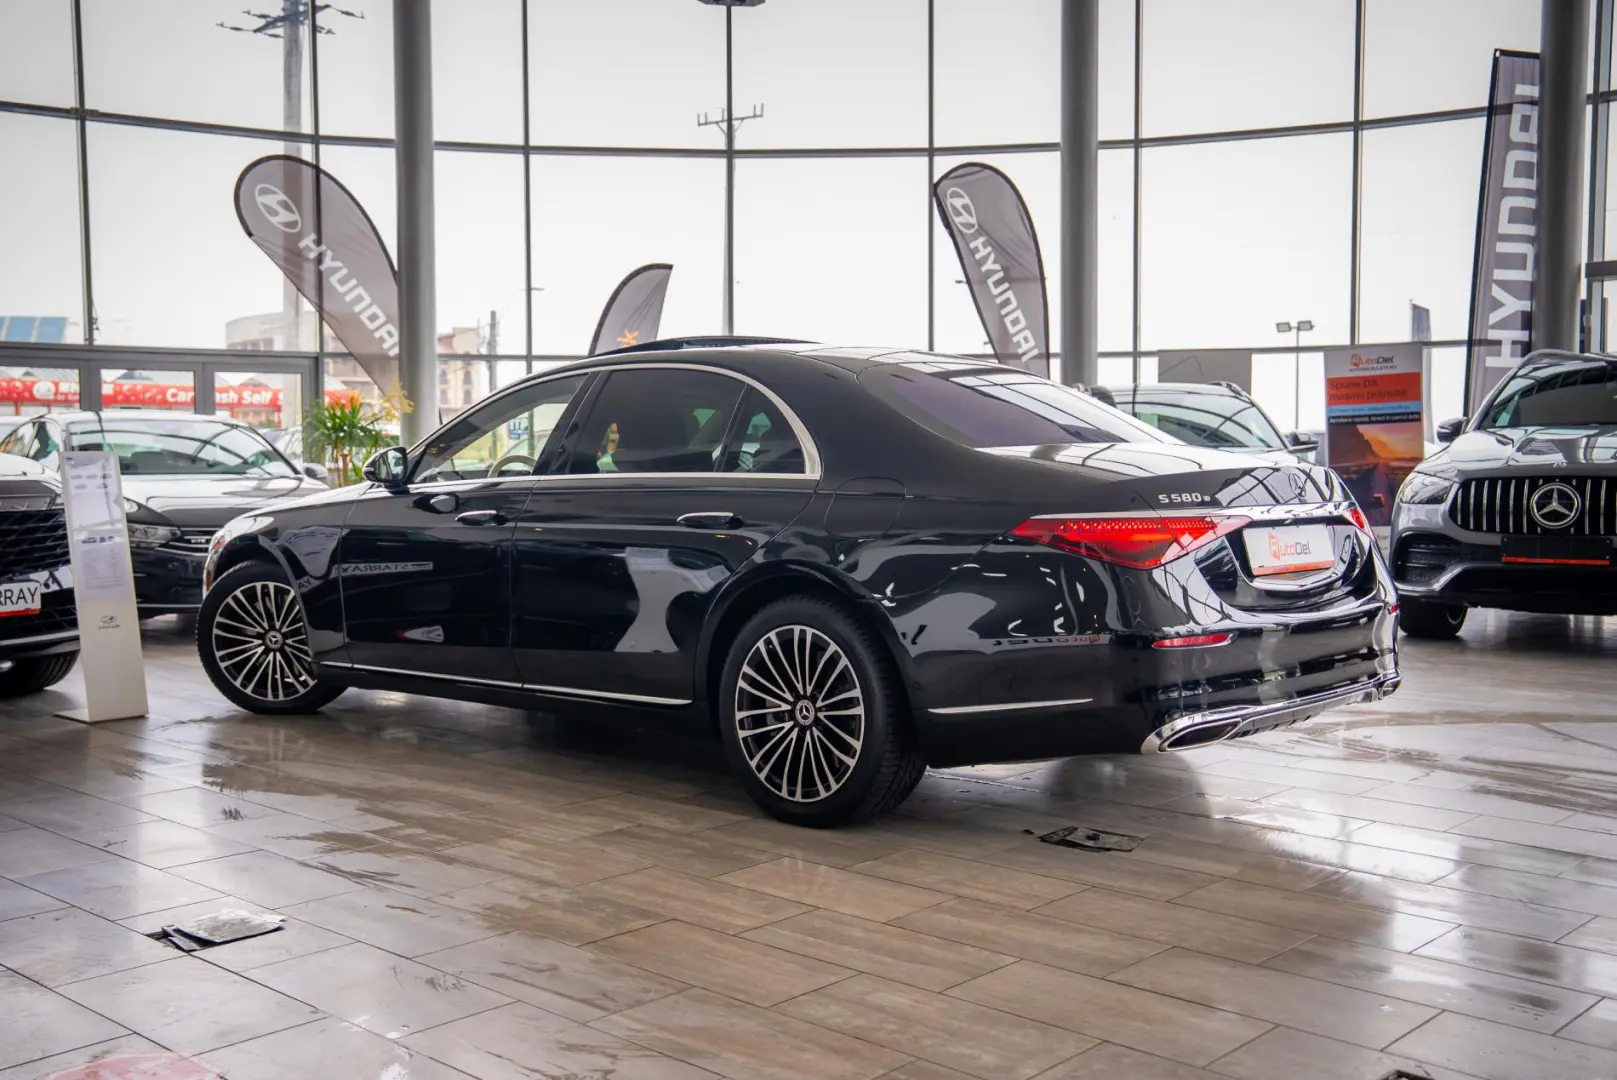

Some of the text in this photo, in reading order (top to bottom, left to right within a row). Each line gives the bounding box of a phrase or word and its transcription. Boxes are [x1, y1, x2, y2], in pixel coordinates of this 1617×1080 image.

[969, 237, 1040, 363] HYUNDAI
[1363, 380, 1379, 388] DA
[166, 388, 194, 402] Car
[241, 390, 272, 404] Self
